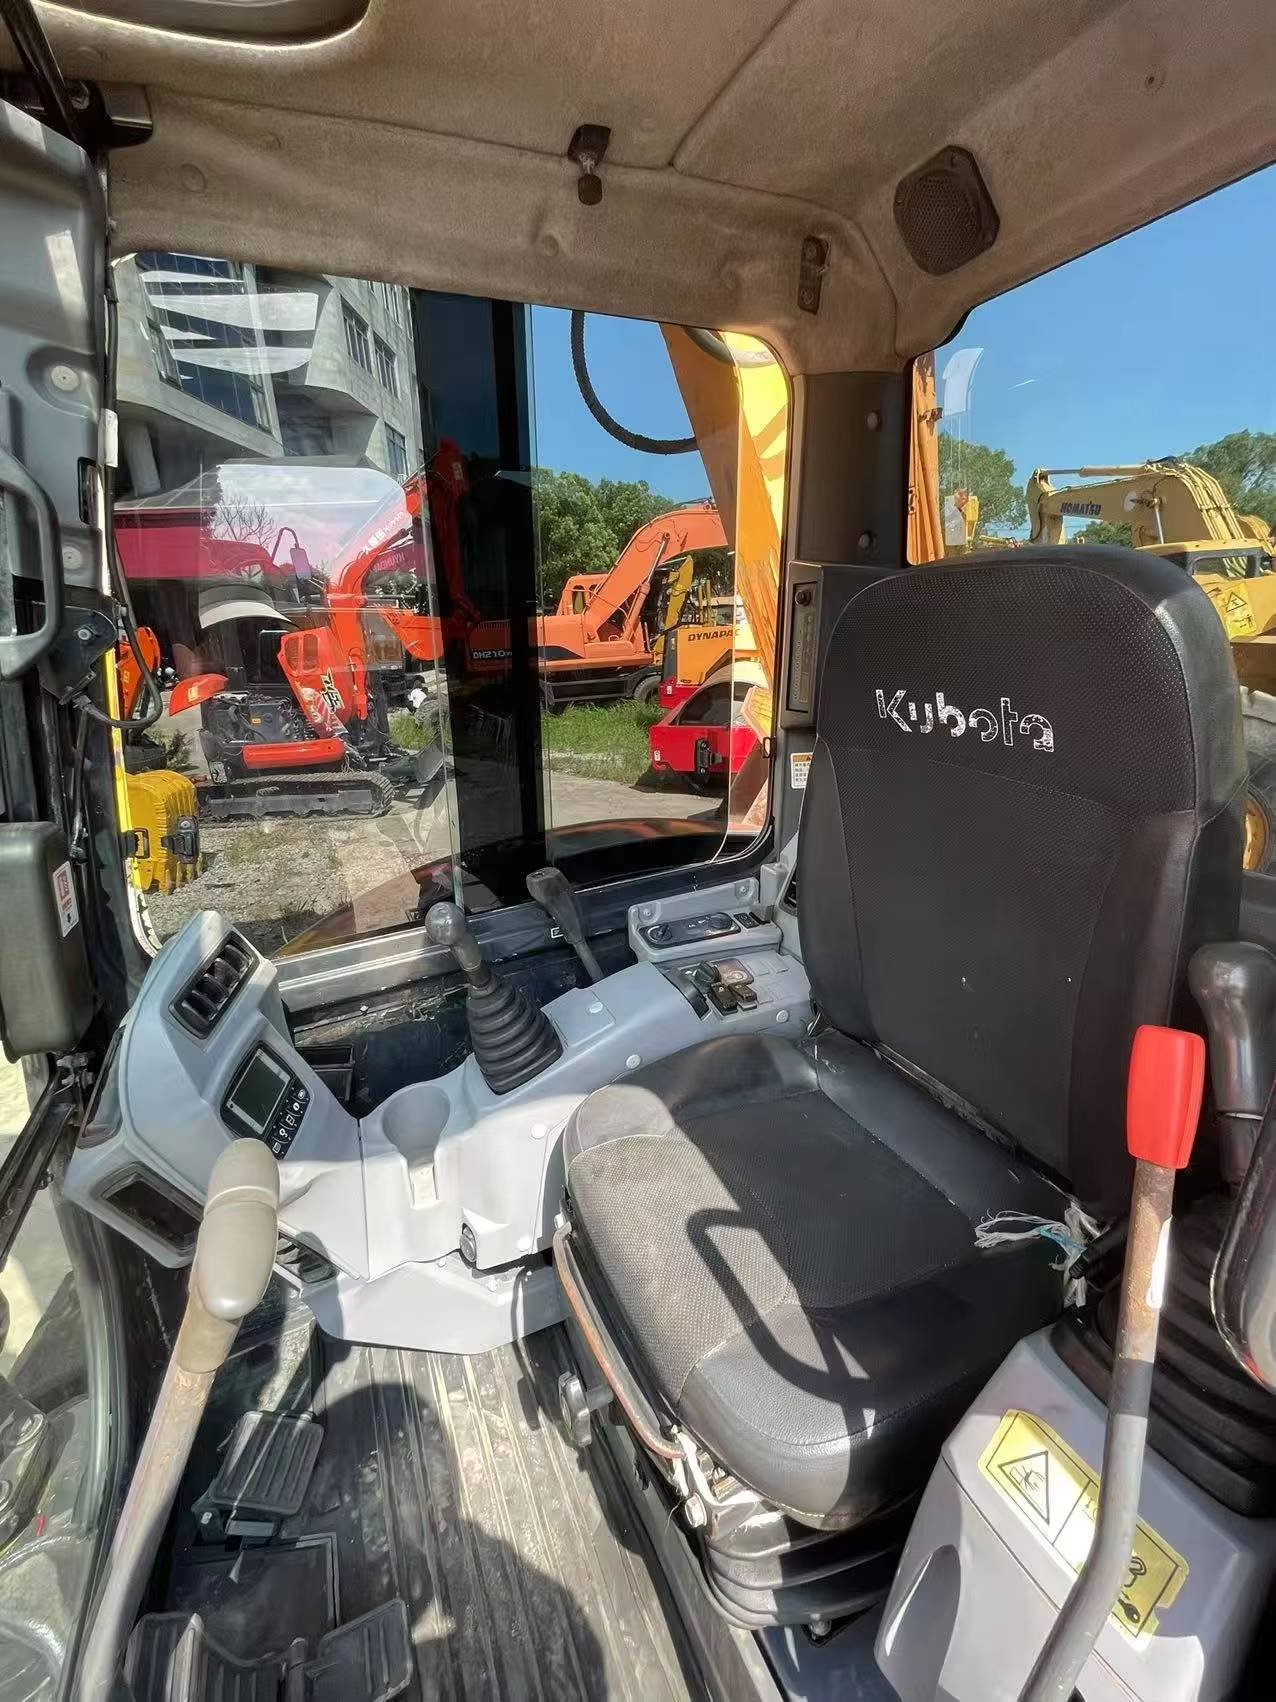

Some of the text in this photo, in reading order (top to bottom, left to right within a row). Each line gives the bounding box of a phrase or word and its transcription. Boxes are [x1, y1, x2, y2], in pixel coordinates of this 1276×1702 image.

[1060, 501, 1102, 516] KOMATSU
[687, 627, 741, 642] DYNAPAC
[875, 688, 1055, 753] Kubota
